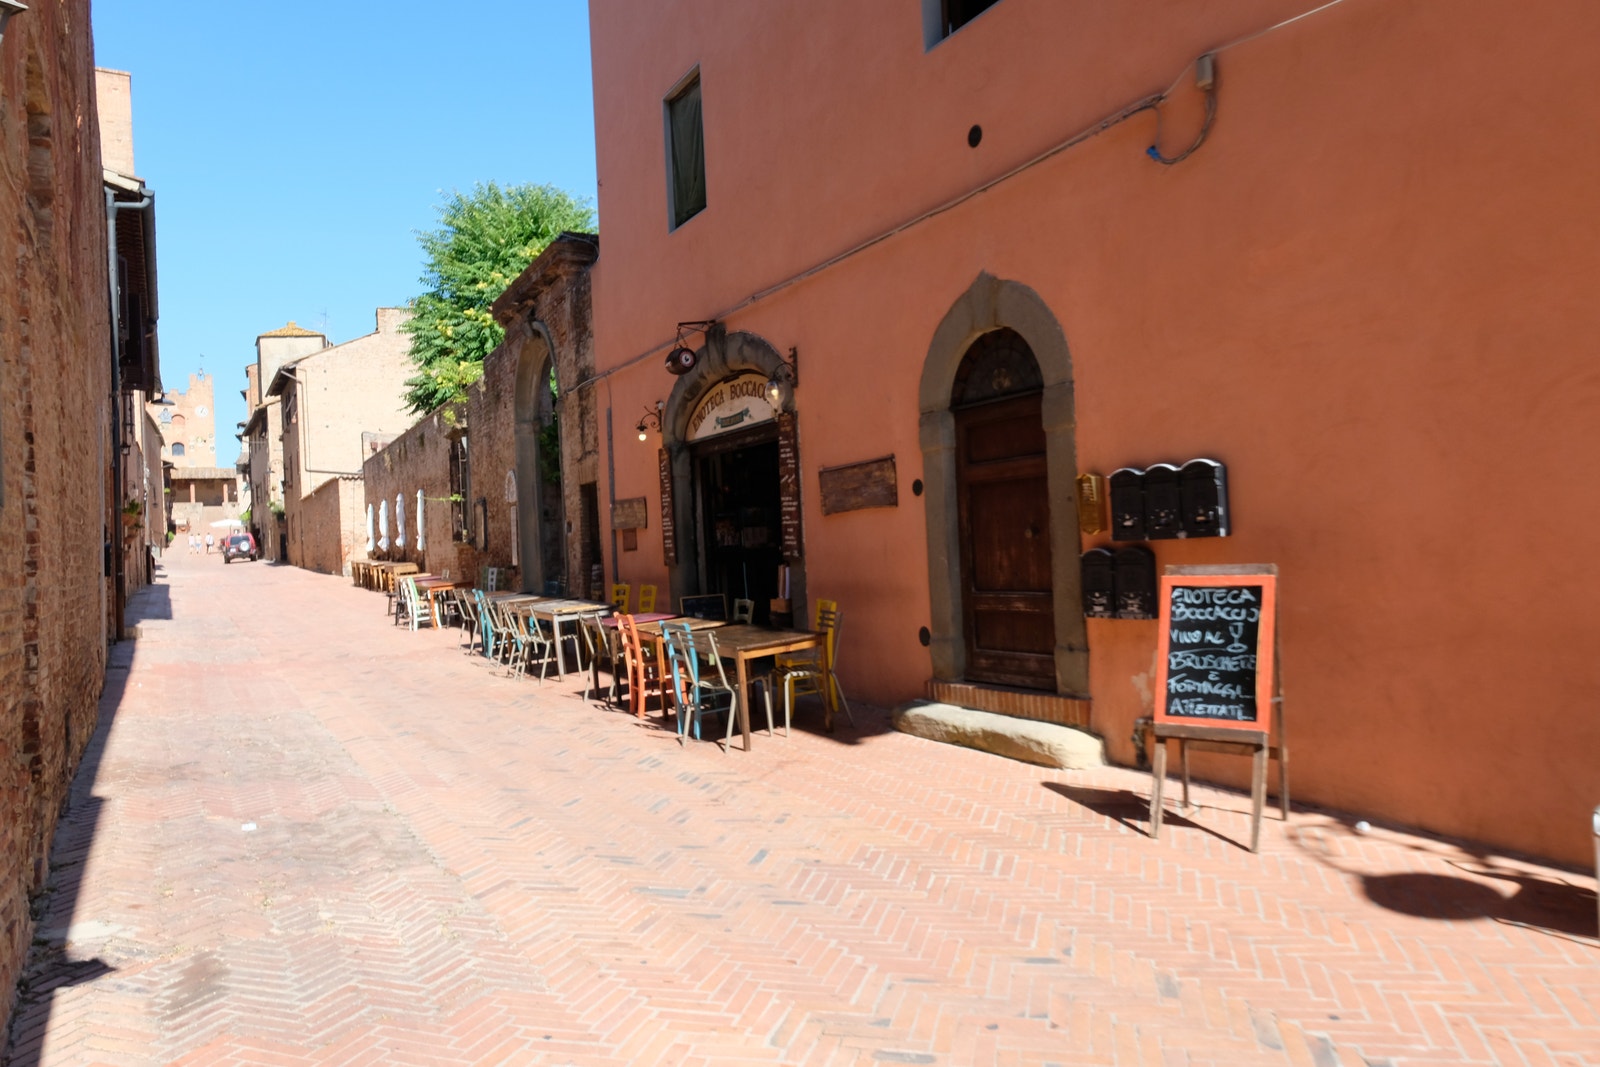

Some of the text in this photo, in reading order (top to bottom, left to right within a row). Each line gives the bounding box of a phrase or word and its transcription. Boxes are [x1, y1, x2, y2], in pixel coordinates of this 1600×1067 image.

[692, 388, 725, 433] ENOTECA
[1170, 587, 1257, 605] ENOTECA
[1170, 602, 1259, 622] BOCCACCIO
[1169, 628, 1226, 644] VINO AL
